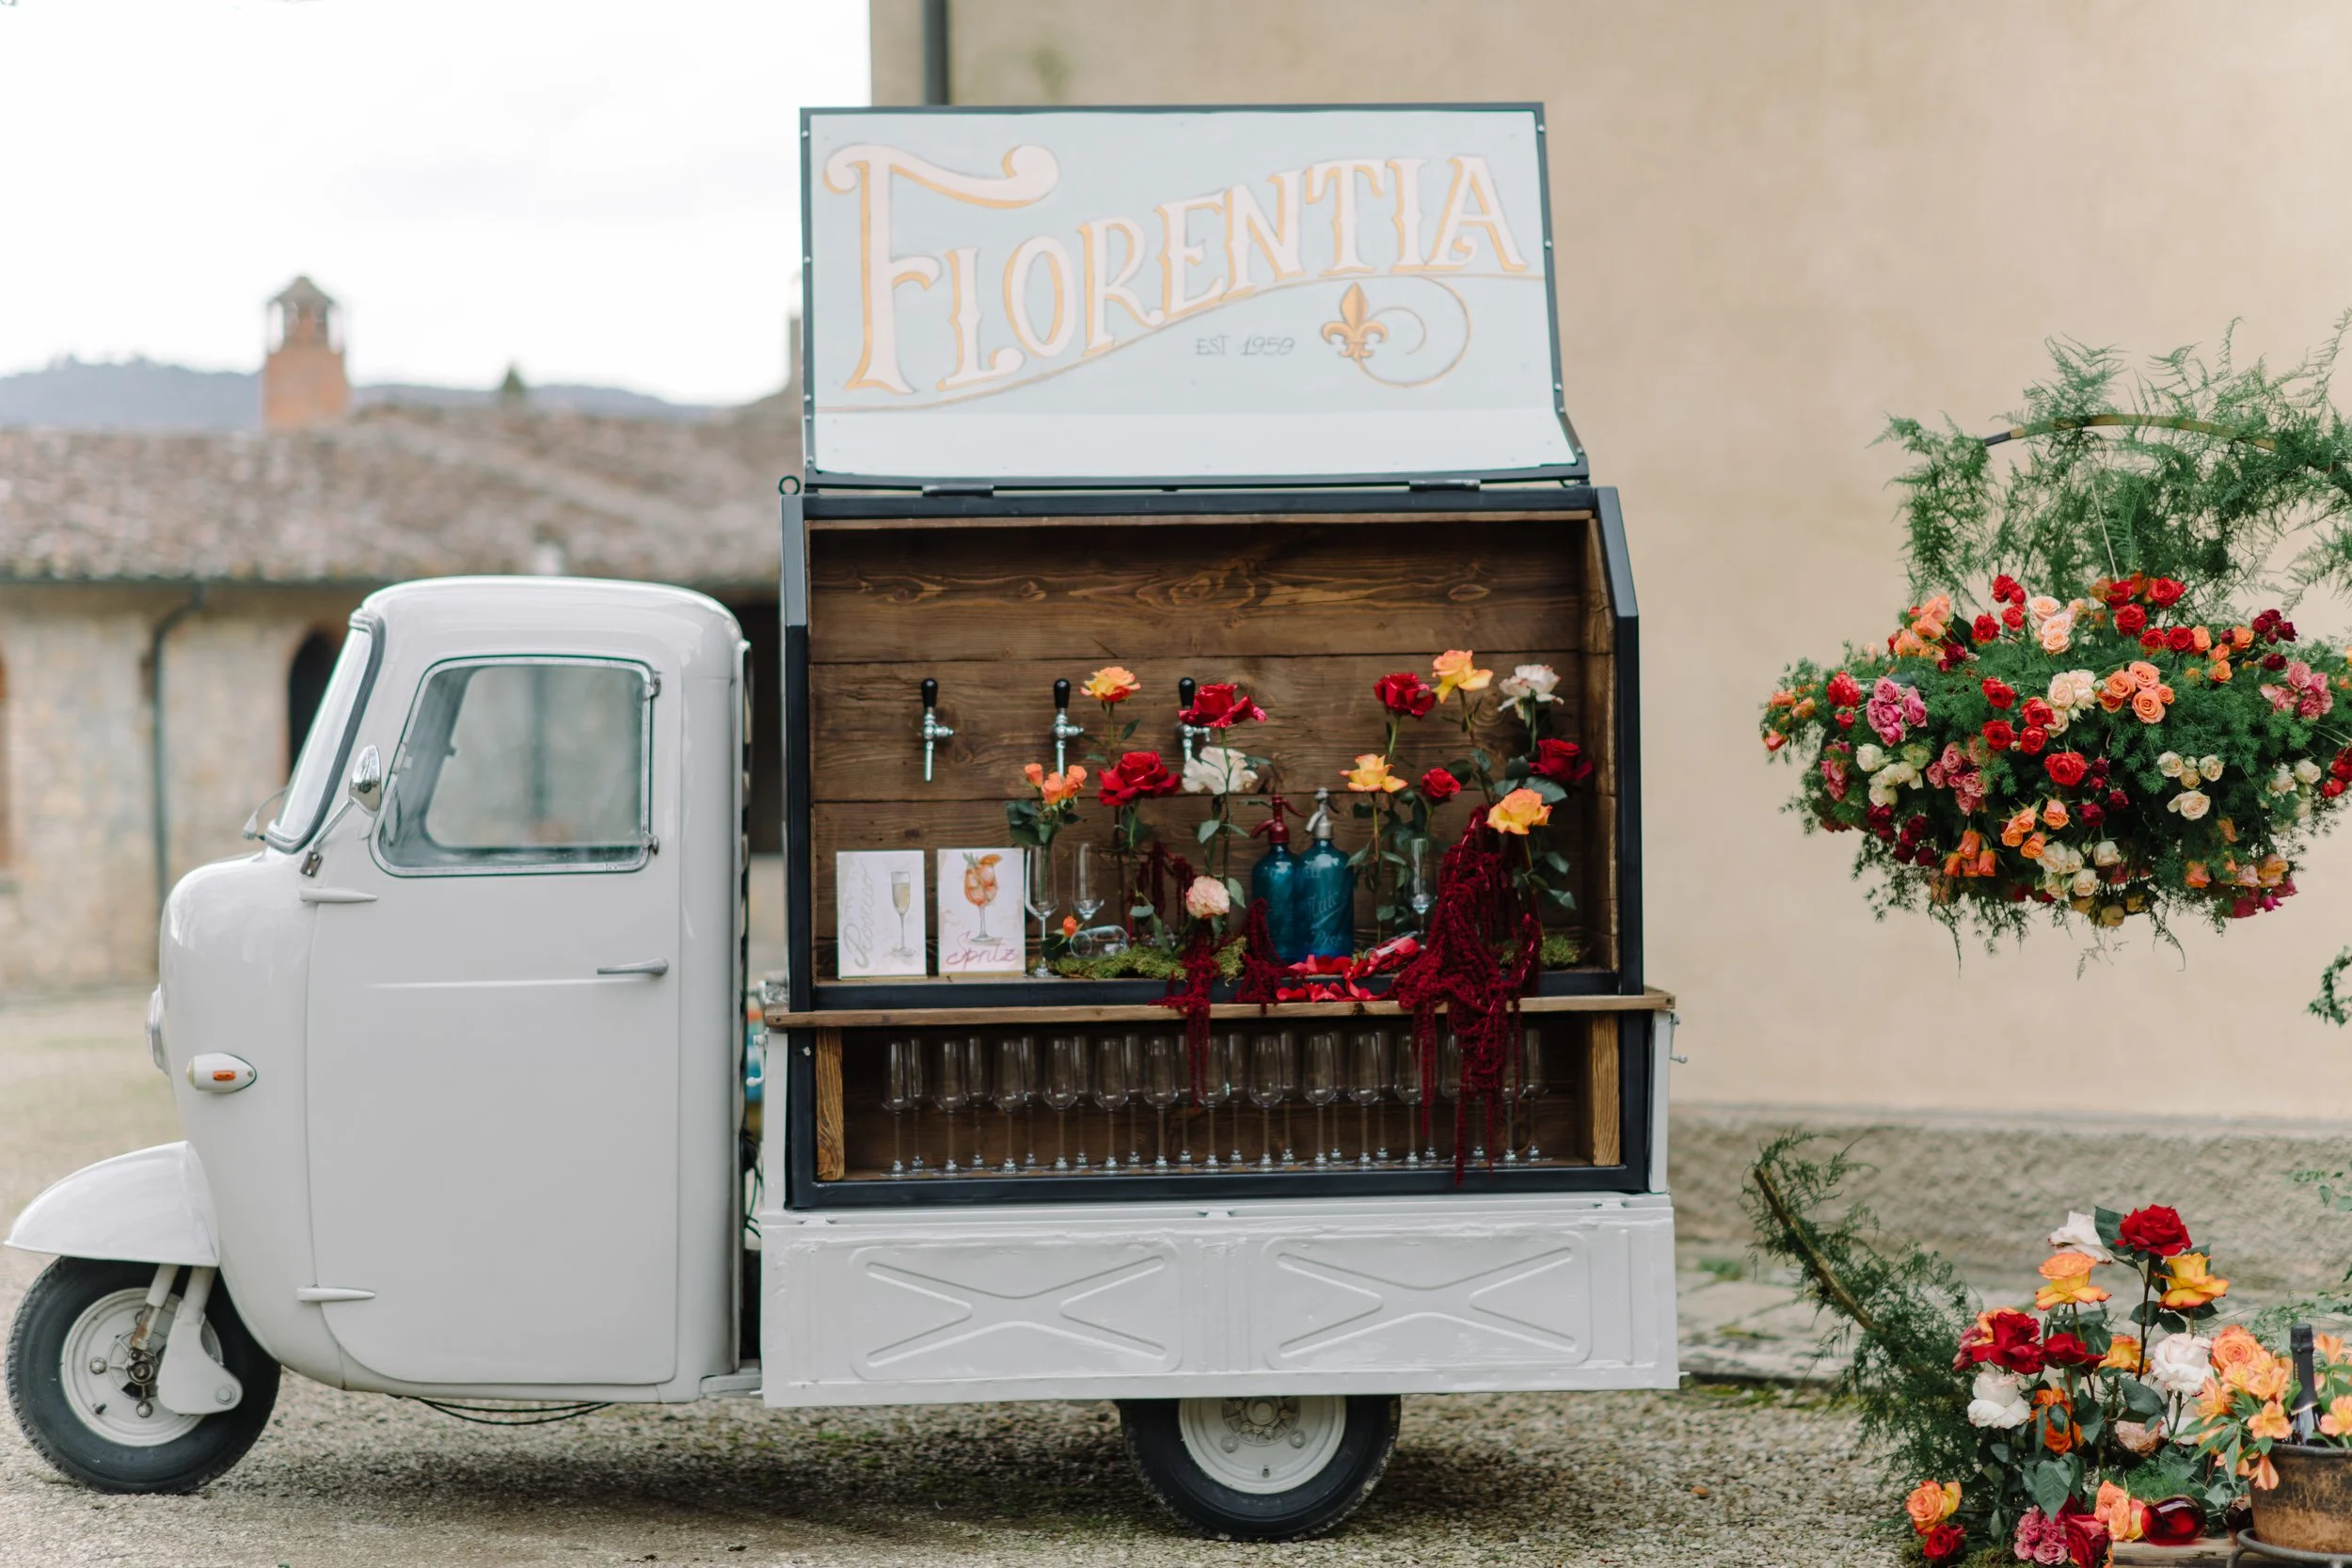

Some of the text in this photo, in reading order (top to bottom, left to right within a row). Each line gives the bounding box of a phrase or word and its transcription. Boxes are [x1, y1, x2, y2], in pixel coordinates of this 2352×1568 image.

[823, 142, 1530, 395] FLORENTIA
[1196, 334, 1295, 356] EST 1959
[945, 929, 1018, 970] Spritz
